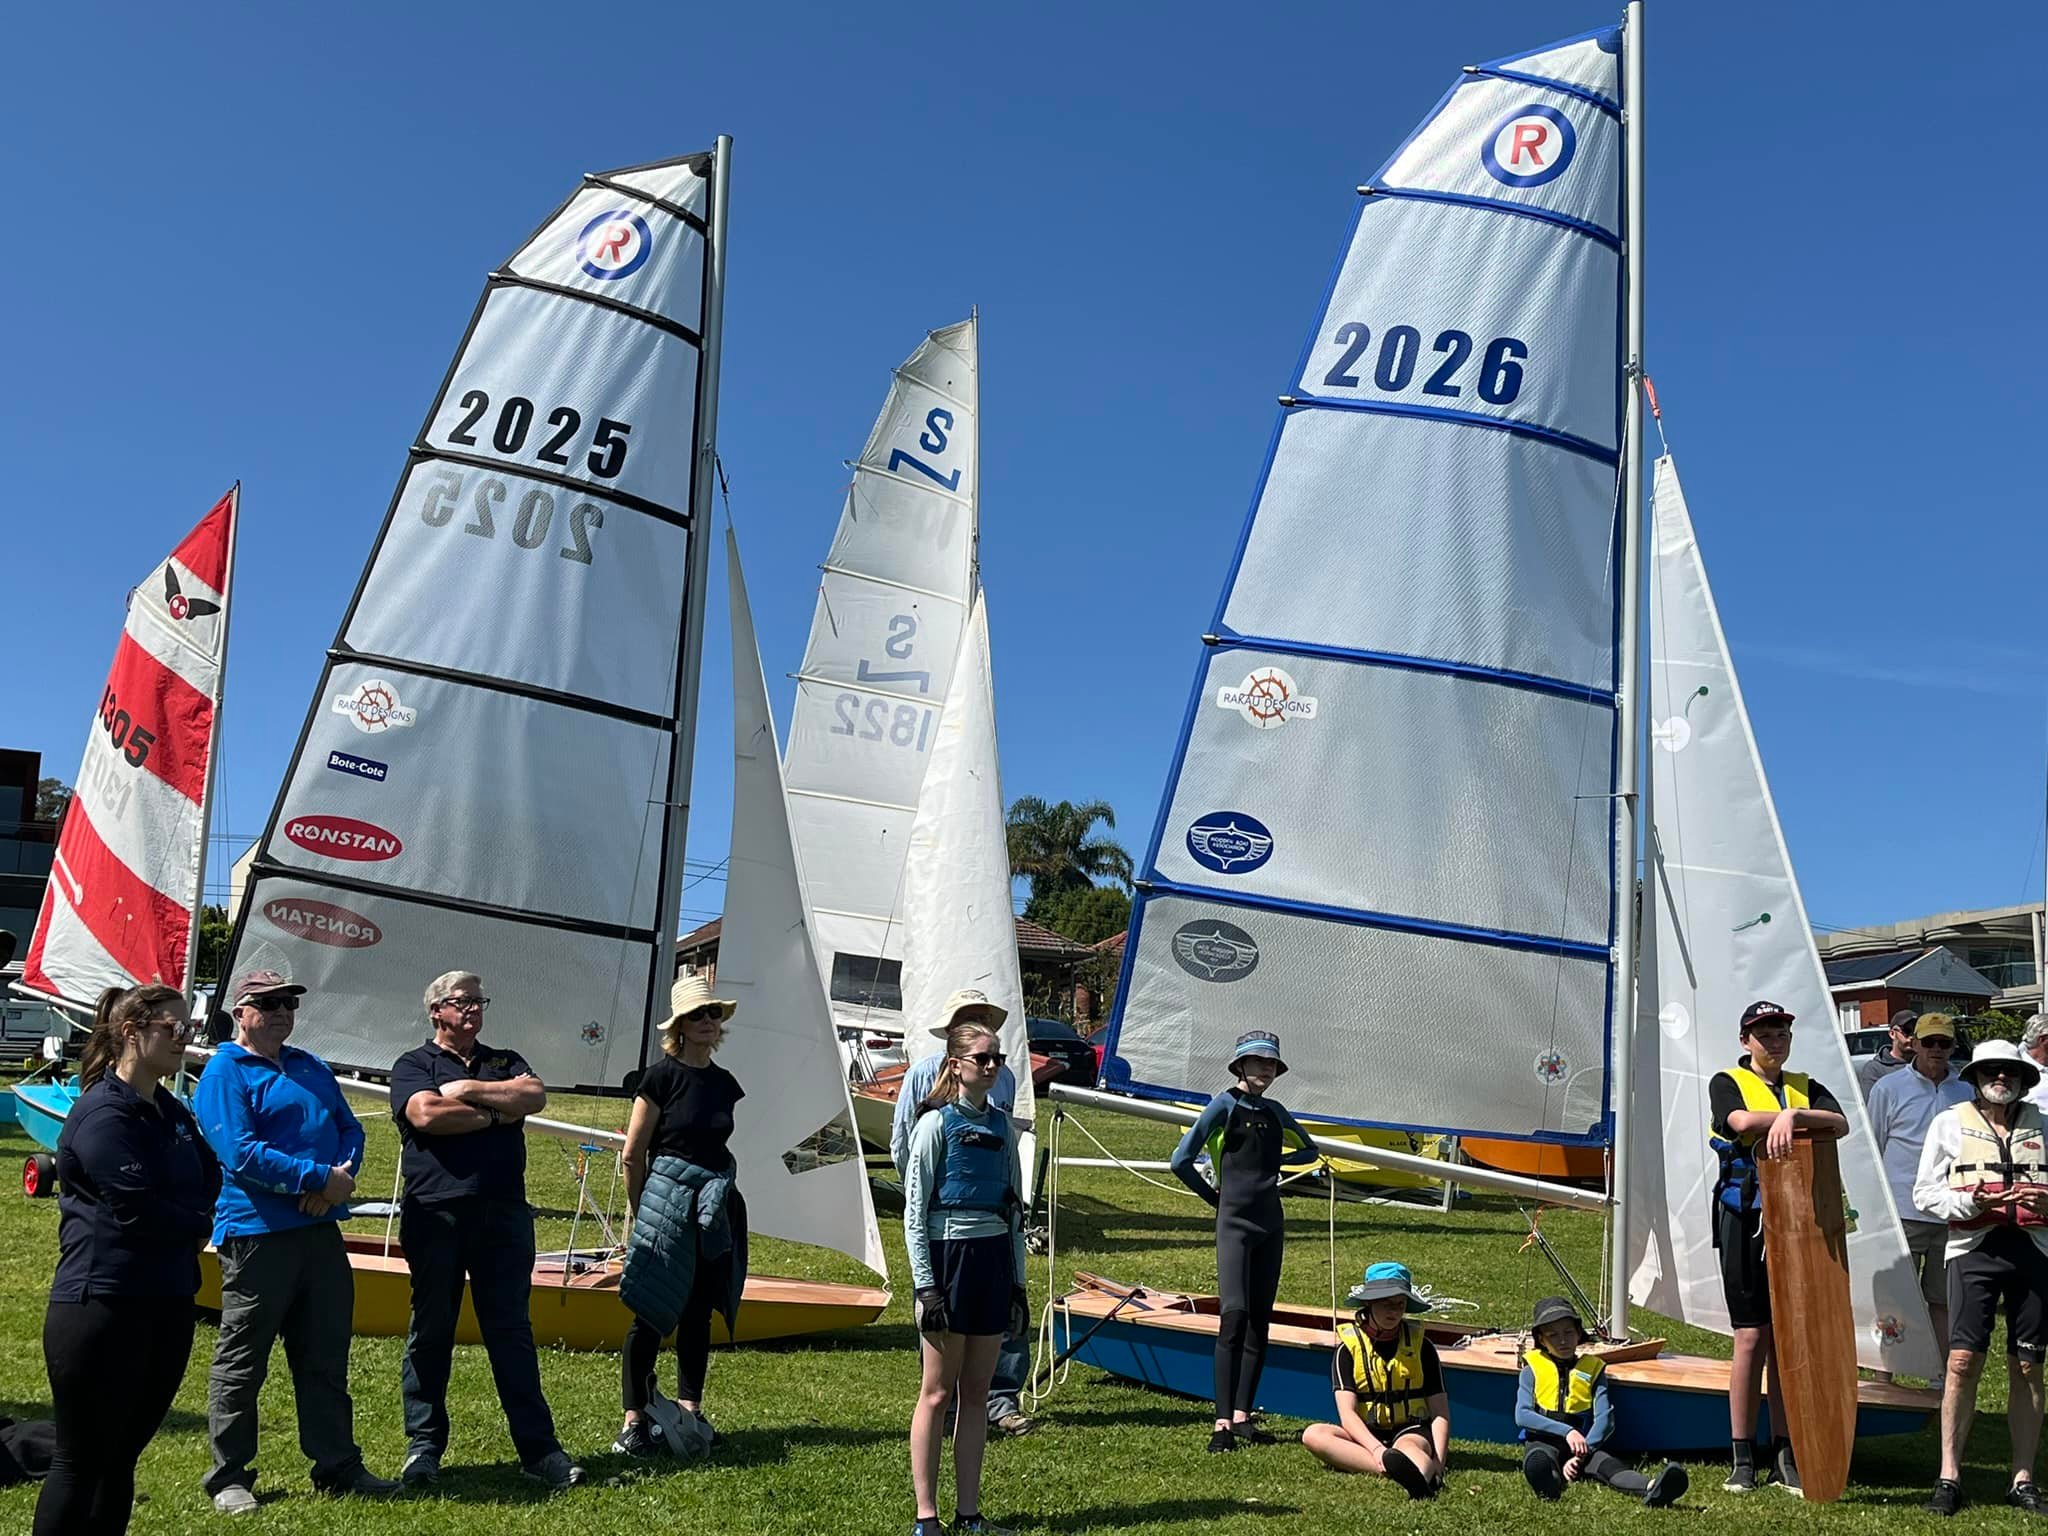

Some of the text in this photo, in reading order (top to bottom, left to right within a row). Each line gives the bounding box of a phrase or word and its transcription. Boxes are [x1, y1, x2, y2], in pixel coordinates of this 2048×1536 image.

[1510, 124, 1547, 165] R
[595, 224, 631, 263] R
[1322, 321, 1529, 405] 2026
[447, 389, 632, 479] 2025
[338, 699, 412, 722] RAKAU DESIGNS
[1223, 693, 1312, 714] RAKAU DESIGNS
[99, 684, 156, 768] 1305
[330, 755, 384, 778] Bote-Cote
[289, 823, 396, 854] RONSTAN
